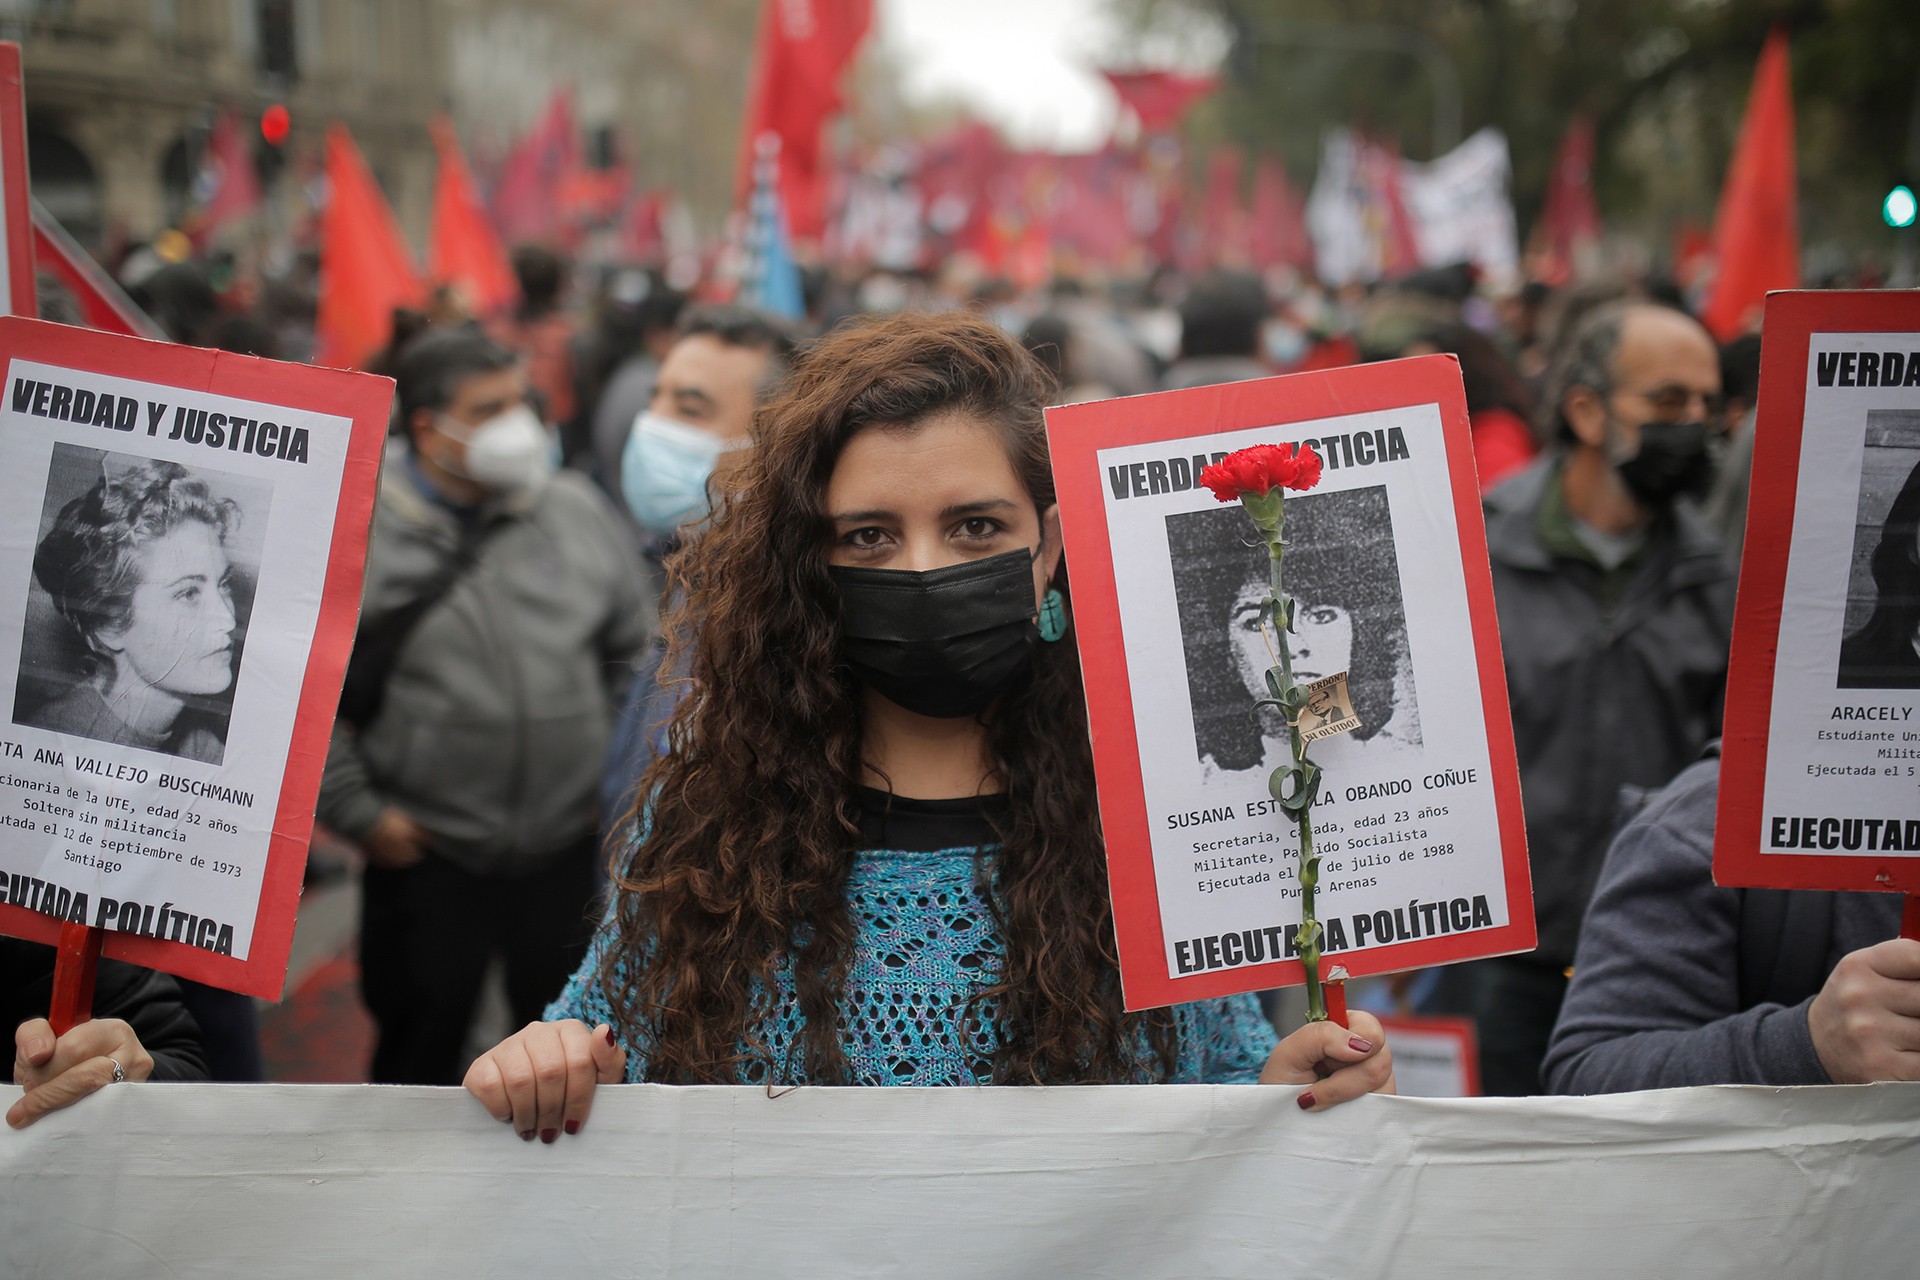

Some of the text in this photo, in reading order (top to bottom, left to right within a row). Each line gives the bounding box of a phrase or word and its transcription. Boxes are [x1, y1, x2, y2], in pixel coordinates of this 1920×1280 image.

[11, 378, 310, 464] VERDAD Y JUSTICIA
[1319, 719, 1357, 736] OLVIDO!
[1818, 730, 1894, 742] Estudiante
[1831, 706, 1913, 721] ARACELY
[0, 741, 255, 808] TA ANA VALLEJO BUSCHMANN
[1807, 765, 1915, 777] Ejecutada el 5
[23, 798, 187, 843] Soltera sin militancia
[66, 787, 79, 800] de
[86, 791, 98, 804] la
[105, 795, 136, 814] UTE,
[146, 804, 179, 820] edad
[186, 812, 201, 825] 32
[208, 817, 238, 835] años
[1168, 806, 1235, 830] SUSANA
[1346, 779, 1412, 802] OBANDO
[1423, 768, 1477, 790] COÑUE
[43, 823, 58, 836] el
[63, 827, 75, 840] 12
[78, 832, 93, 845] de
[100, 837, 183, 863] septiembre
[190, 855, 205, 868] de
[212, 860, 242, 878] 1973
[1192, 831, 1280, 854] Secretaria,
[1354, 814, 1386, 829] edad
[1394, 810, 1410, 823] 23
[1418, 805, 1449, 819] años
[1194, 854, 1274, 873] Militante,
[1347, 829, 1428, 850] Socialista
[64, 849, 122, 874] Santiago
[1199, 843, 1454, 893] Ejecutada el de julio de 1988
[1329, 876, 1377, 893] Arenas
[95, 897, 234, 957] POLÍTICA
[1353, 894, 1493, 948] POLÍTICA
